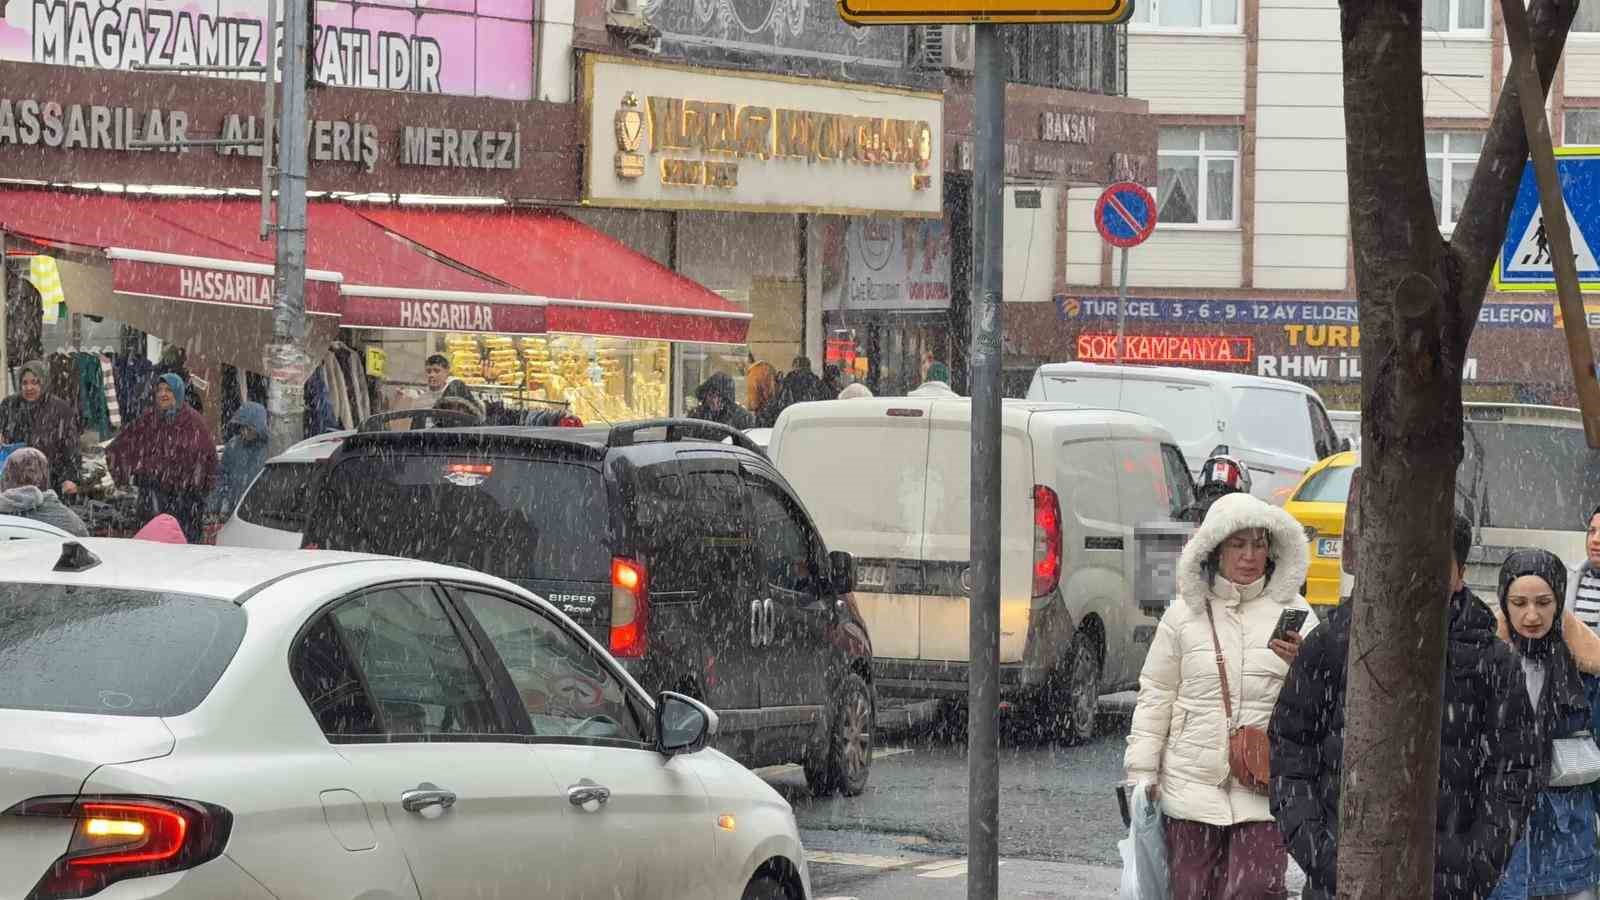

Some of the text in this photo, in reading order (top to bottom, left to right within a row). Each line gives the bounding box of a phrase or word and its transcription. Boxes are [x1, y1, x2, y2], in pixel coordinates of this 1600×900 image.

[34, 0, 262, 80] MAĞAZAMIZ
[0, 99, 520, 173] ASSARILAR ALERİŞ MERKEZİ
[180, 268, 275, 304] HASSARILA
[400, 301, 494, 330] HASSARILAR
[1252, 305, 1269, 319] 12
[1273, 305, 1297, 319] AY
[1302, 306, 1358, 321] ELDEN
[1479, 308, 1546, 323] ELEFON
[1126, 336, 1231, 360] KAMPANYA
[1257, 355, 1328, 377] RHM
[1326, 541, 1338, 553] 34
